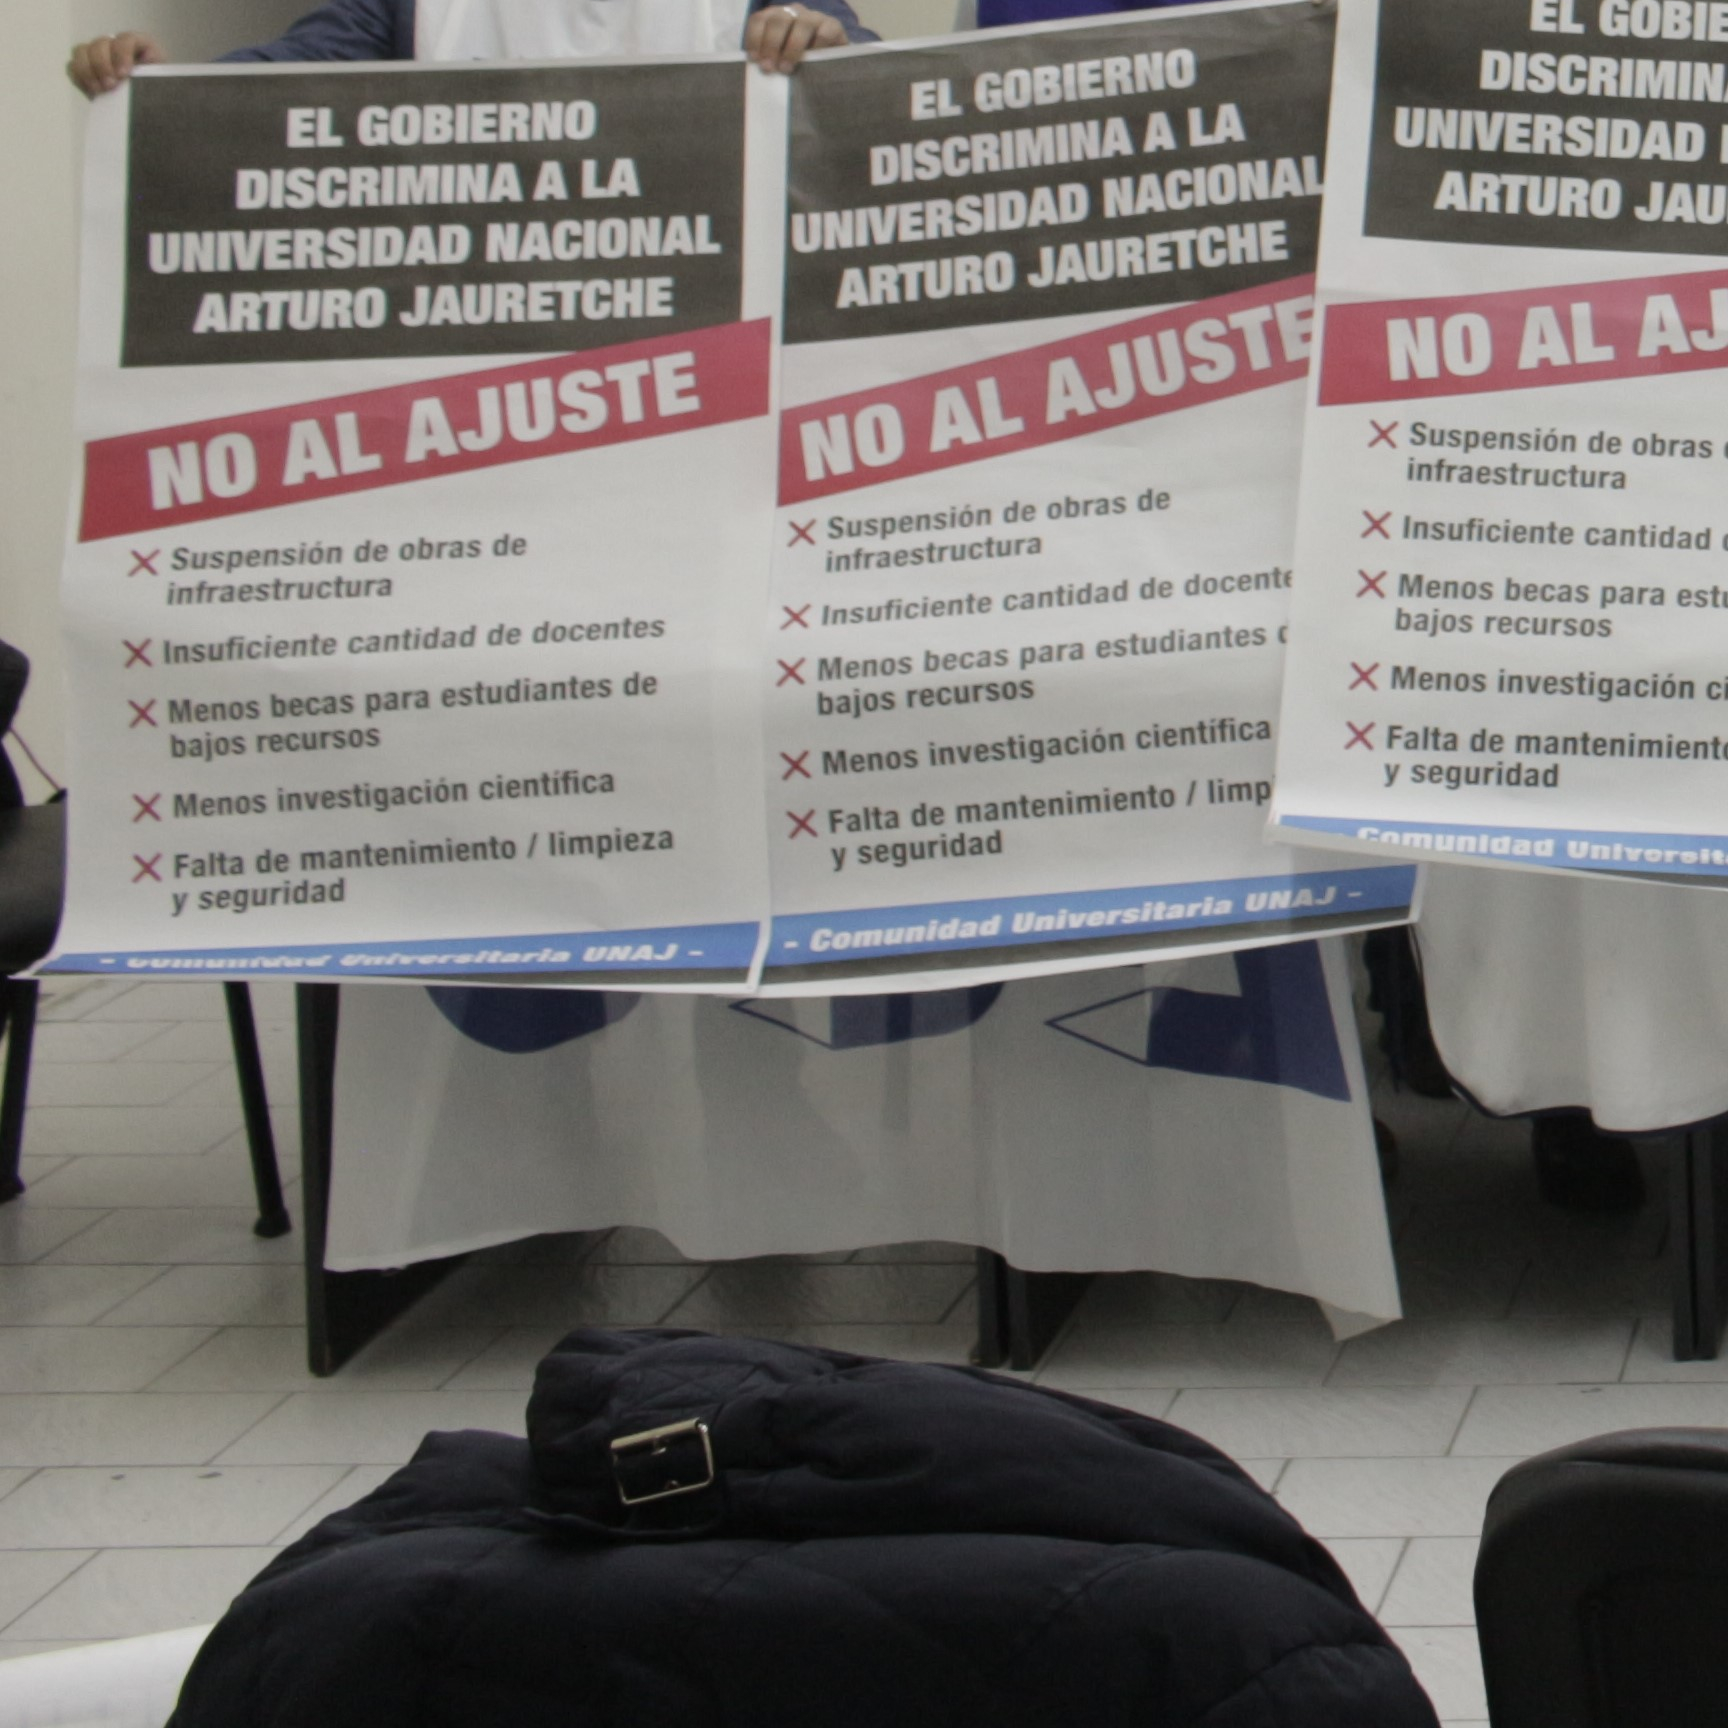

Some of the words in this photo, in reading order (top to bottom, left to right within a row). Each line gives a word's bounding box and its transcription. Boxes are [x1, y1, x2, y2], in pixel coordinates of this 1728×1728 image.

[1394, 106, 1706, 162] UNIVERSIDAD
[1433, 170, 1622, 220] ARTURO
[1385, 312, 1495, 382] NO
[1517, 301, 1615, 371] AL
[147, 432, 259, 512] NO
[282, 411, 383, 487] AL
[403, 352, 700, 465] AJUSTE
[799, 404, 904, 482] NO
[928, 377, 1027, 453] AL
[170, 541, 343, 574] Suspensión
[354, 539, 389, 564] de
[398, 537, 481, 561] obras
[492, 533, 527, 557] de
[166, 575, 393, 606] infraestructura
[162, 633, 337, 666] Insuficiente
[347, 624, 477, 655] cantidad
[487, 623, 522, 647] de
[532, 616, 665, 644] docentes
[168, 698, 261, 724] Menos
[270, 693, 355, 718] becas
[365, 689, 430, 719] para
[440, 675, 613, 708] estudiantes
[623, 672, 657, 697] de
[170, 731, 247, 763] bajos
[256, 727, 381, 754] recursos
[173, 792, 267, 818] Menos
[277, 777, 468, 813] investigación
[478, 769, 615, 801] científica
[174, 852, 245, 879] Falta
[255, 848, 290, 874] de
[299, 835, 517, 871] mantenimiento
[549, 827, 674, 860] limpieza
[171, 892, 189, 918] y
[198, 876, 346, 914] seguridad
[809, 913, 1003, 952] Comunidad
[1010, 895, 1234, 934] Universitaria
[1243, 887, 1335, 913] UNAJ
[339, 947, 572, 967] Universitaria
[582, 943, 679, 962] UNAJ
